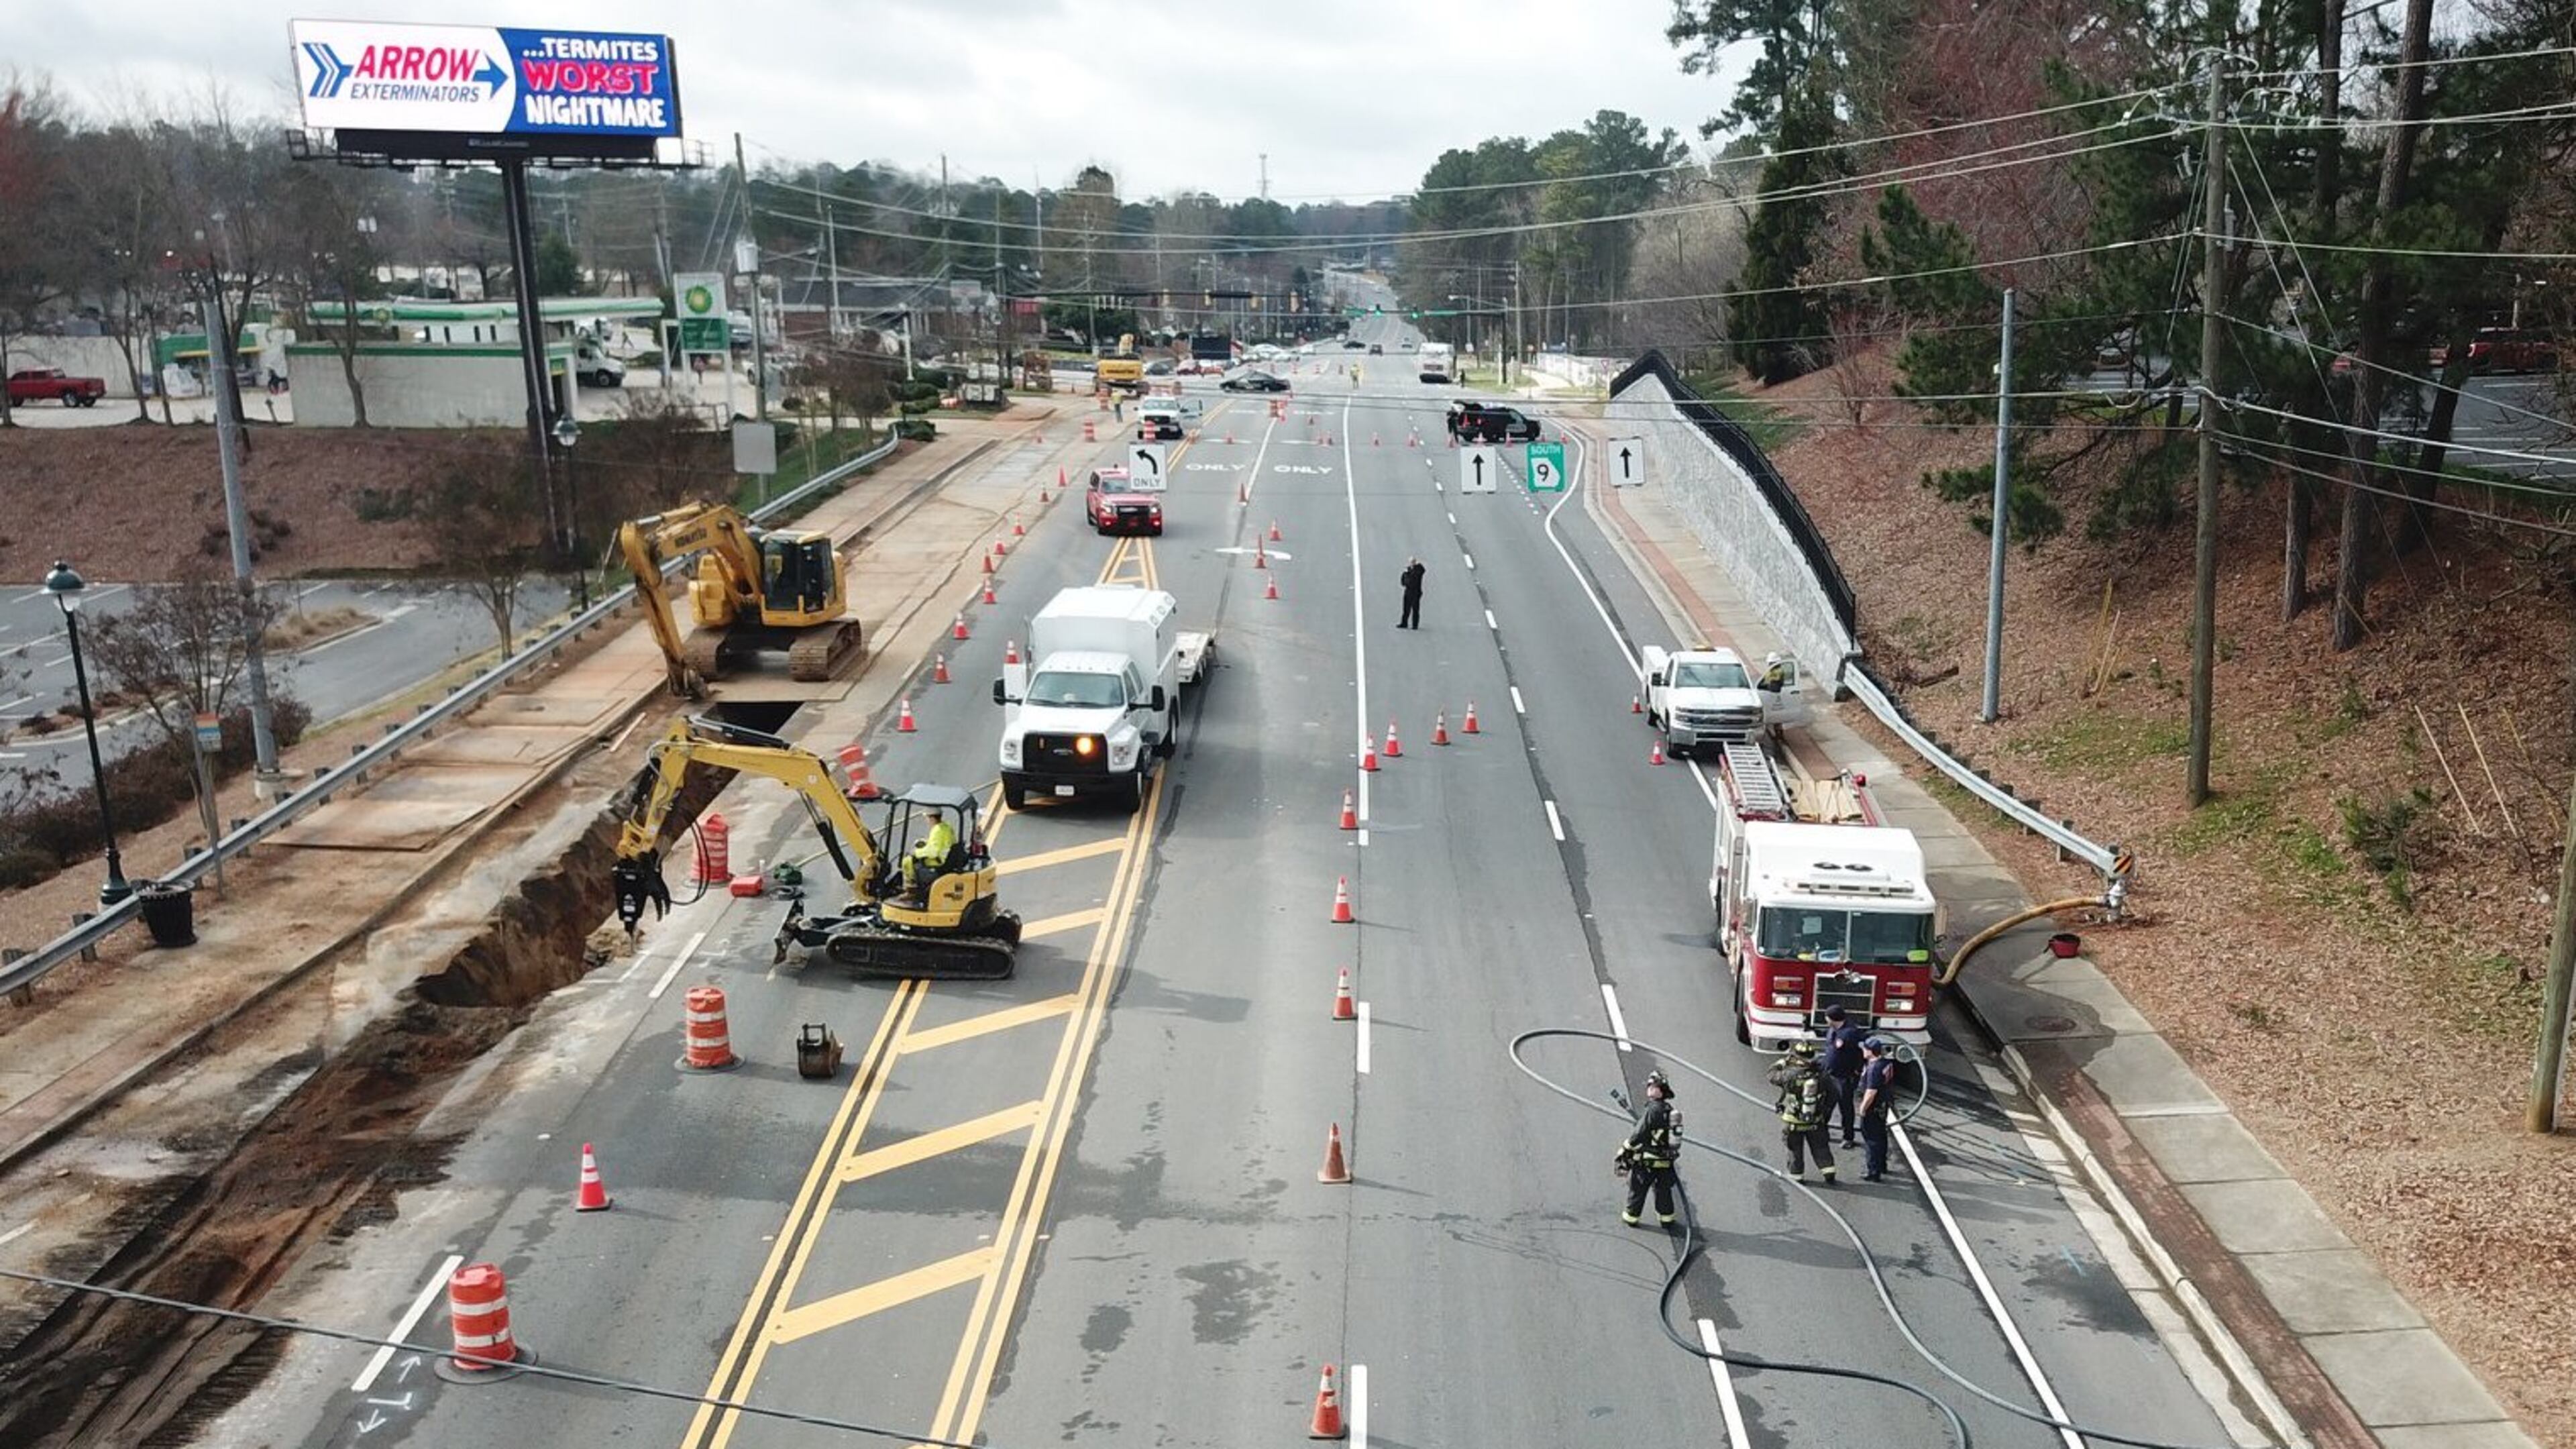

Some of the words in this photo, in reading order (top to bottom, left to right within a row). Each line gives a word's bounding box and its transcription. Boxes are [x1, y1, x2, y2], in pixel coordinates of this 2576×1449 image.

[354, 45, 480, 82] ARROW
[521, 59, 659, 95] WORST
[350, 83, 480, 103] EXTERMINATORS
[525, 94, 667, 127] NIGHTMARE
[1531, 445, 1561, 455] SOUTH
[1185, 464, 1246, 472] ONLY
[1274, 464, 1334, 474] ONLY
[1537, 464, 1549, 482] 9
[1133, 478, 1161, 488] ONLY
